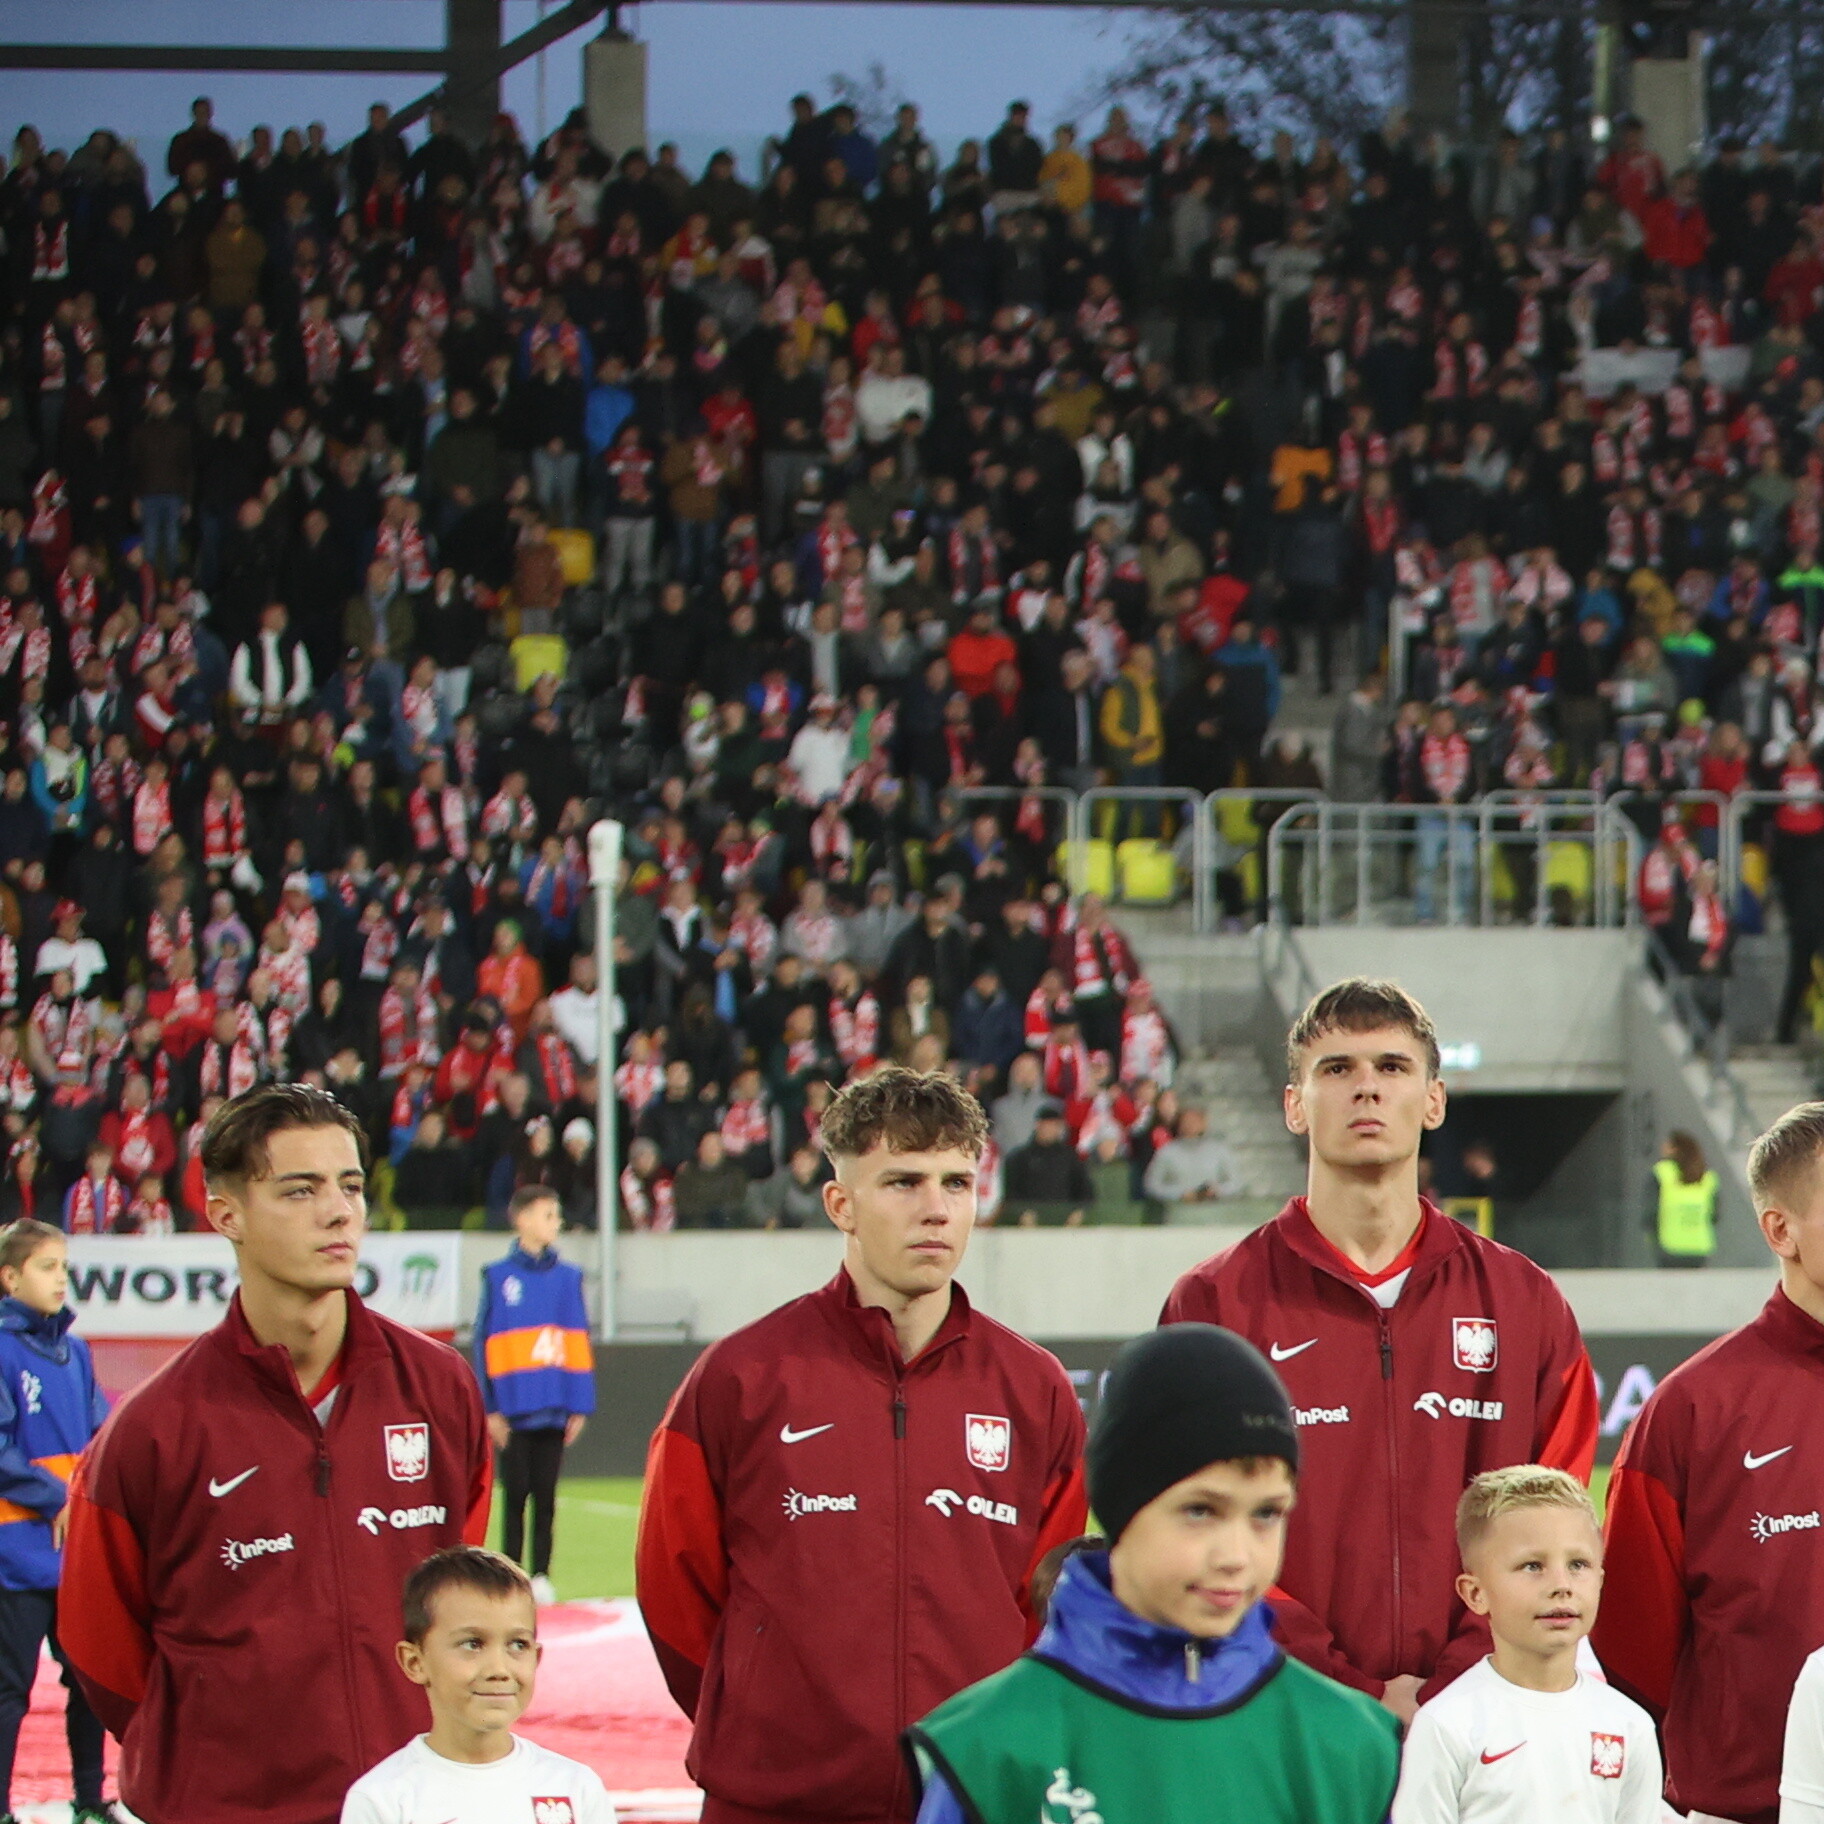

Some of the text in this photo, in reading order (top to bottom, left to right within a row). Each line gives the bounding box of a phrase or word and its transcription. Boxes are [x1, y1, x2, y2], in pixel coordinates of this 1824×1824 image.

[1295, 1405, 1349, 1425] InPost
[801, 1493, 857, 1512] InPost
[1769, 1511, 1821, 1533] InPost
[240, 1532, 294, 1559] InPost
